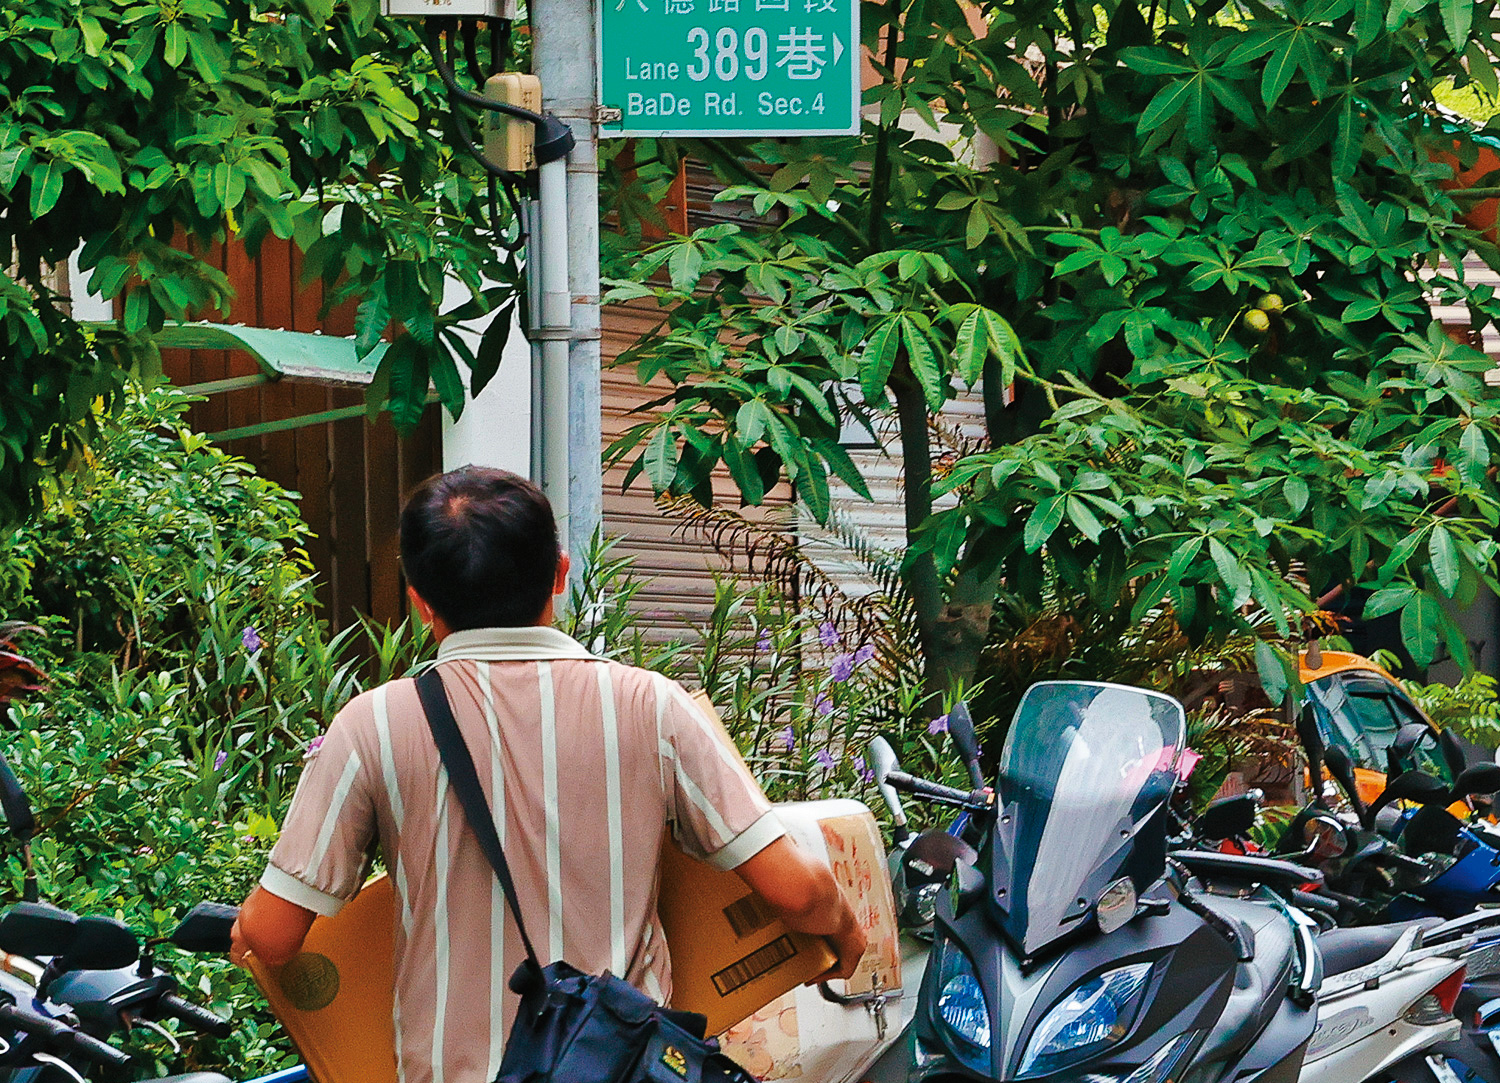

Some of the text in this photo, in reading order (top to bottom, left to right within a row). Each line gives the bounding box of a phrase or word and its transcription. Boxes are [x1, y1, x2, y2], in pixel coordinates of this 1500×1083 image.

[625, 57, 679, 80] Lane
[627, 91, 826, 116] BaDe Rd. Sec.4
